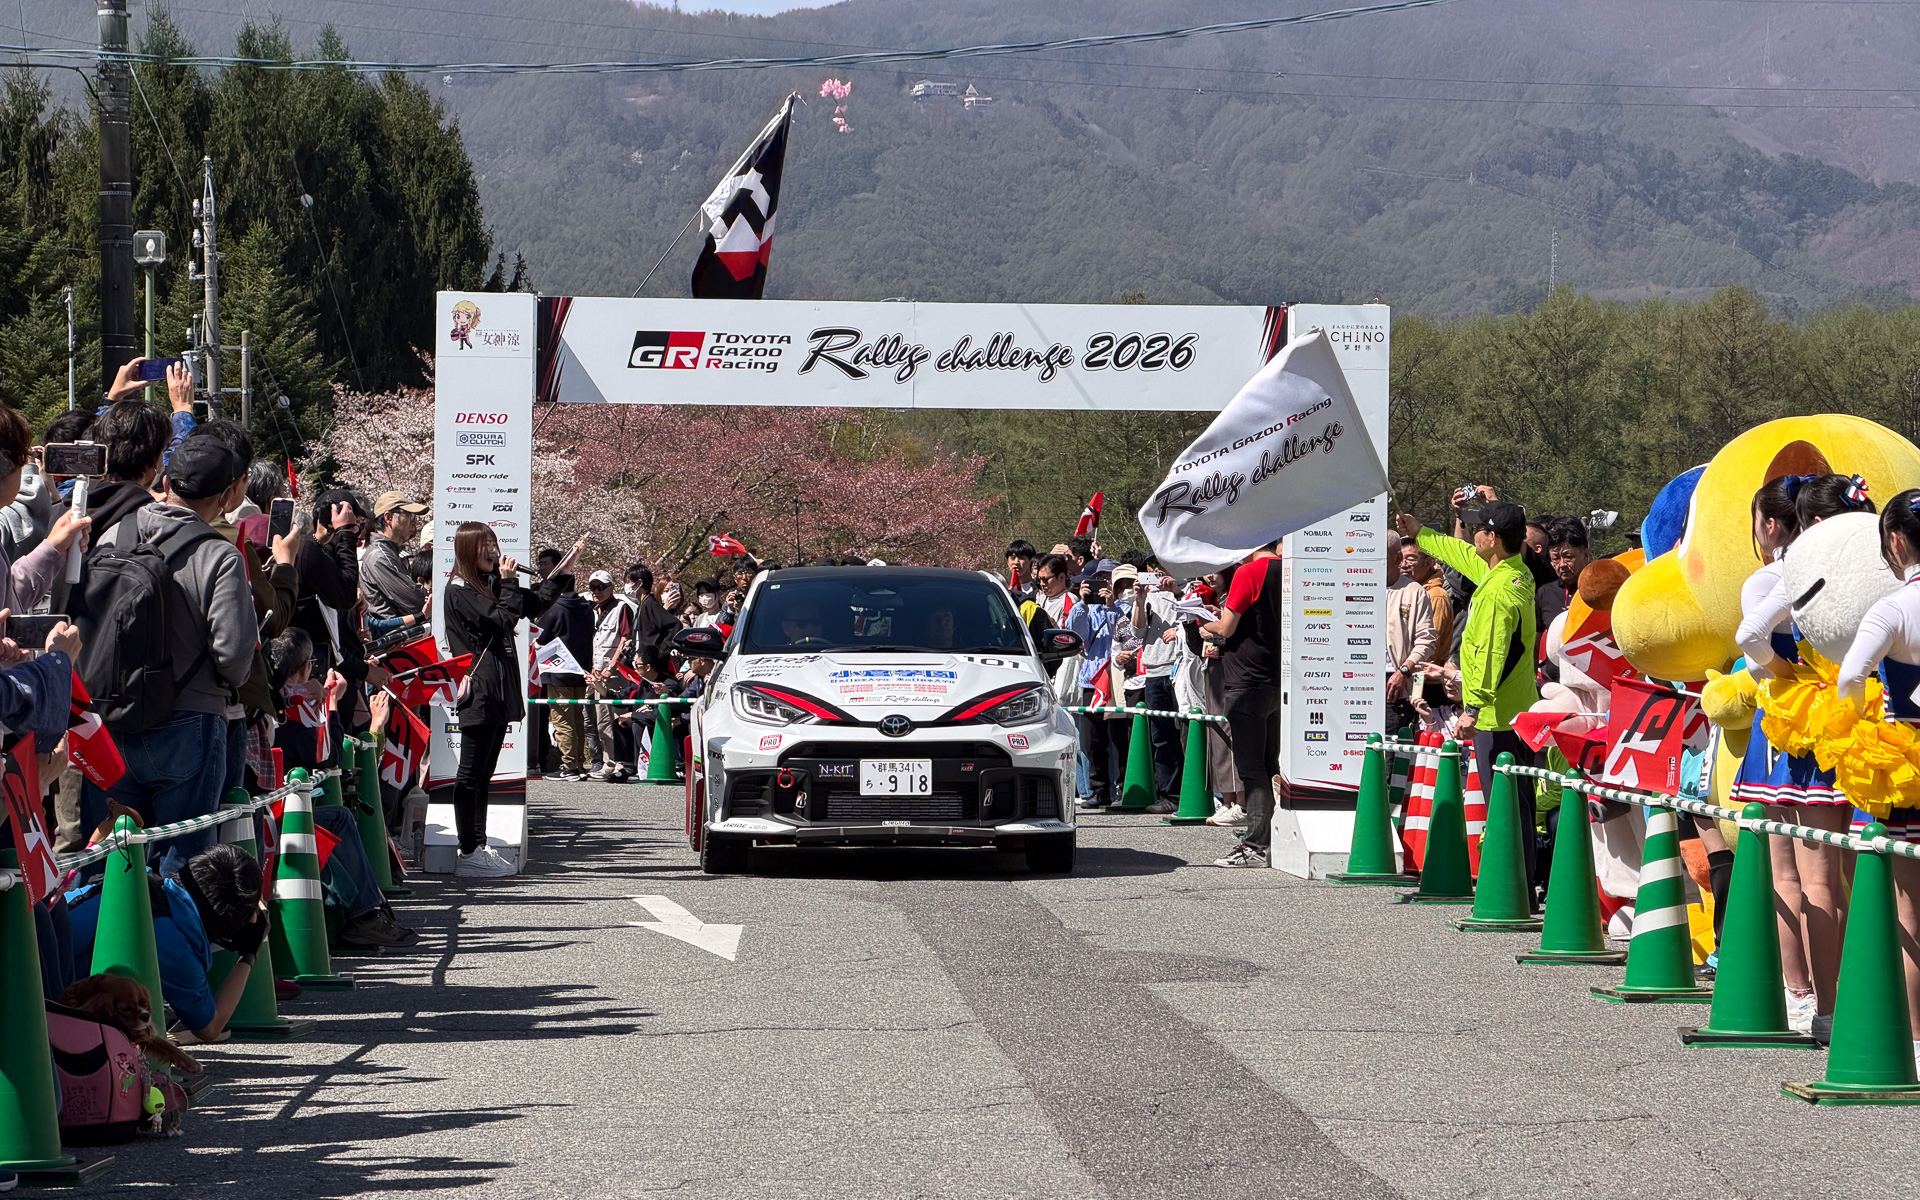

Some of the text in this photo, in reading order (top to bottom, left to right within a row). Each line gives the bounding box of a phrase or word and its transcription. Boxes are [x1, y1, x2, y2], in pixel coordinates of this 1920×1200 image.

[712, 333, 791, 344] TOYOTA
[631, 346, 699, 368] GR
[708, 346, 782, 356] GAZOO
[797, 326, 1200, 384] Rally challenge 2026
[706, 358, 778, 373] Racing
[455, 412, 508, 424] DENSO
[1173, 398, 1332, 475] TOYOTA GAZOO Racing
[466, 454, 495, 466] SPK
[1153, 421, 1345, 529] Rally challenge
[963, 656, 1020, 669] 101
[381, 702, 412, 790] GR
[763, 738, 777, 746] PRO
[1011, 738, 1025, 746] PRO
[878, 762, 914, 772] 群馬 341
[866, 779, 874, 789] ち
